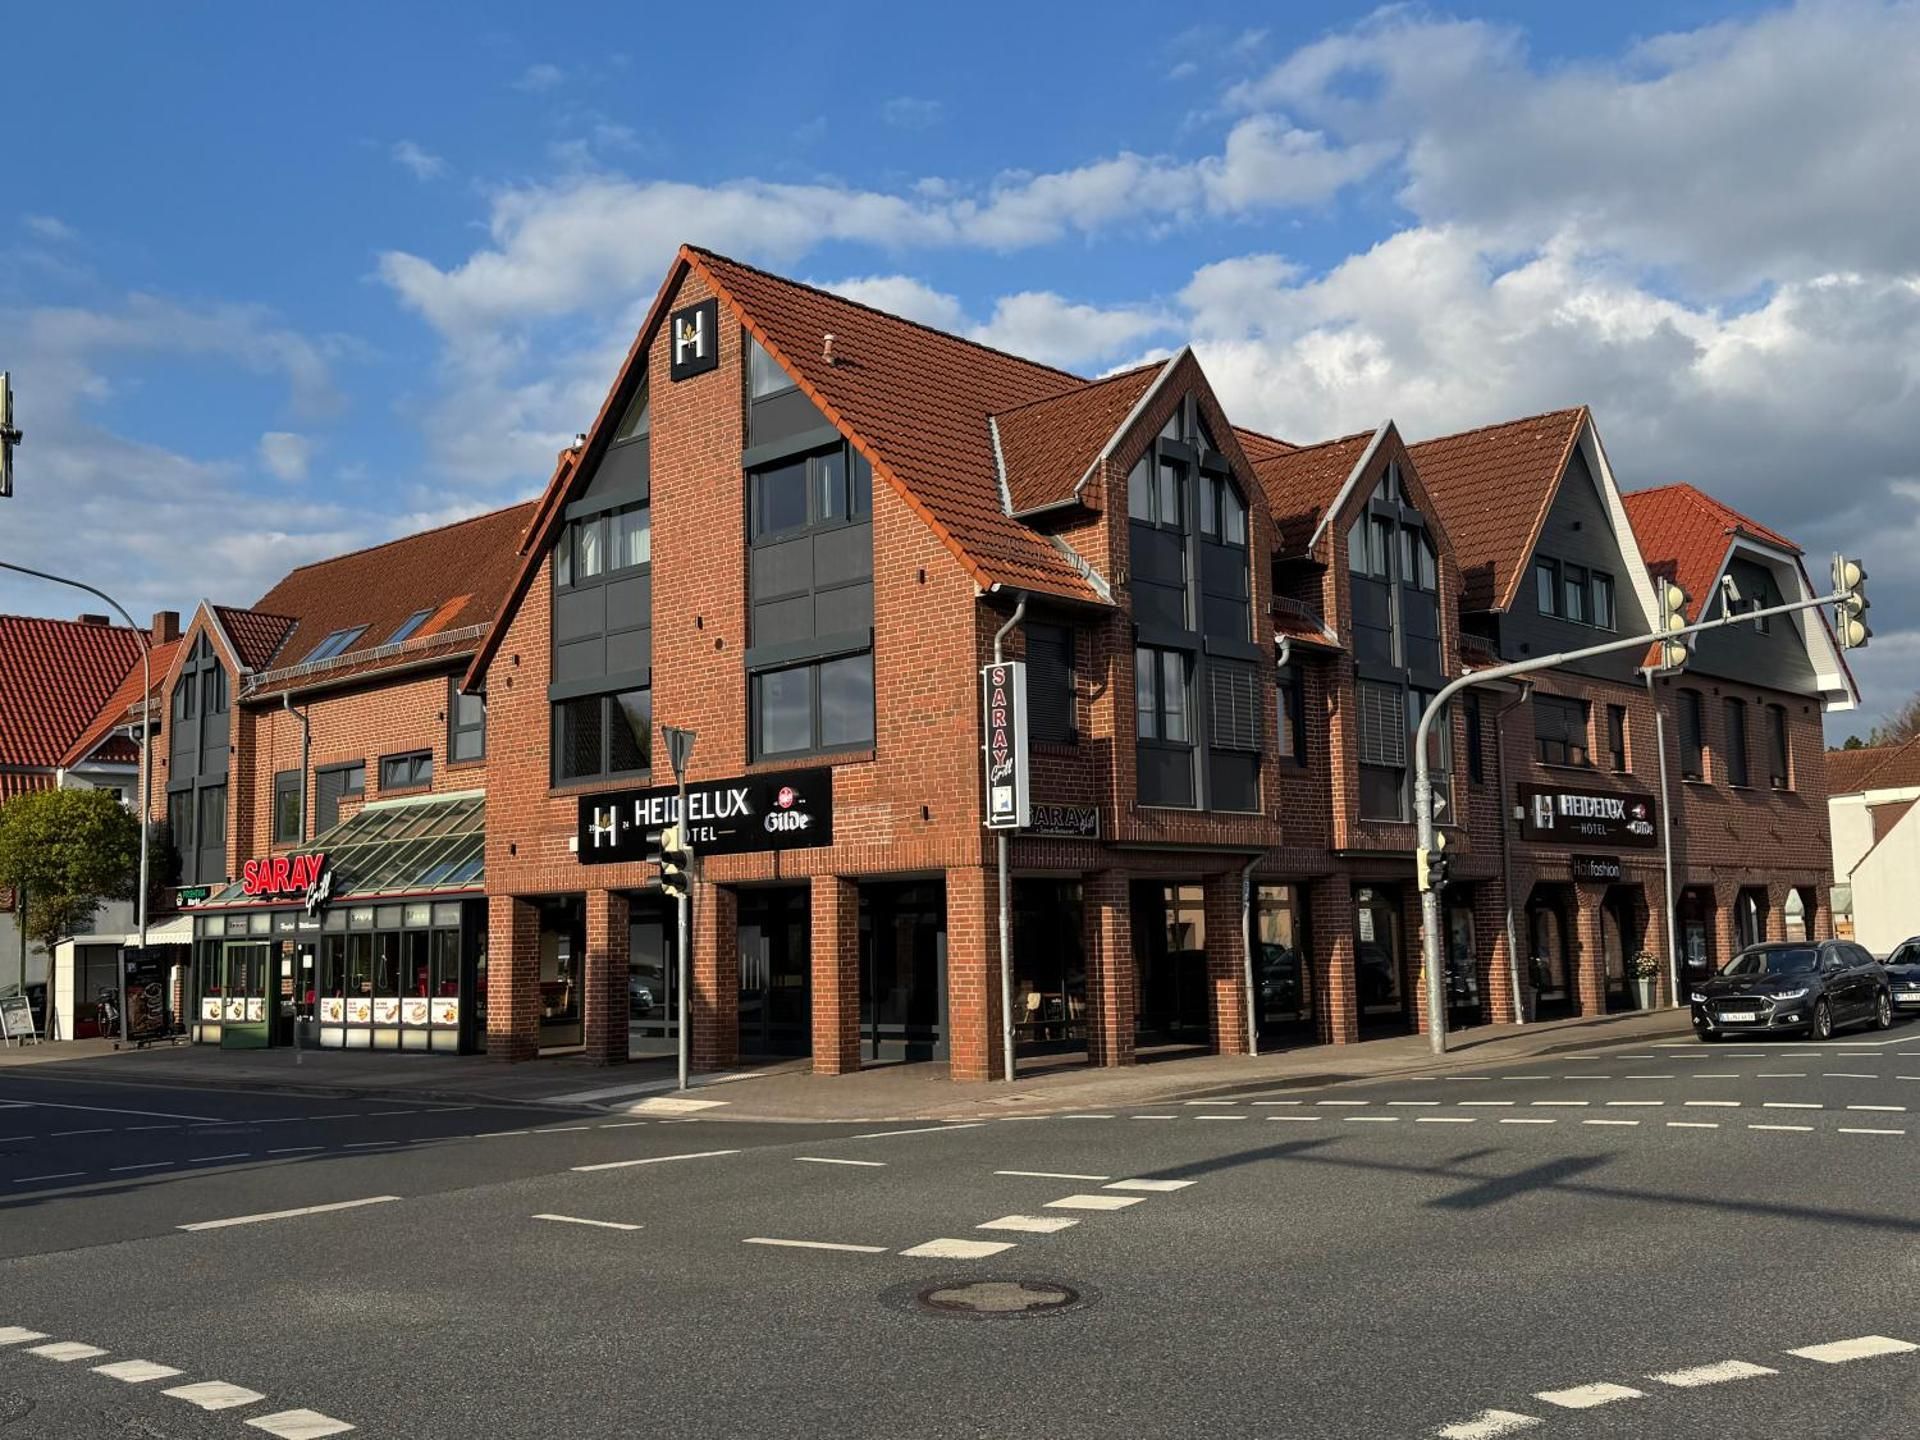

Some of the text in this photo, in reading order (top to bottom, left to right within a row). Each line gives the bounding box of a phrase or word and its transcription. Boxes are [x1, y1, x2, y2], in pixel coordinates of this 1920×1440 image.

[676, 310, 703, 365] H
[991, 667, 1008, 766] SARAY
[990, 757, 1014, 786] Grill
[594, 805, 617, 848] H
[764, 810, 809, 833] Gilde
[1560, 794, 1626, 820] HEIDELUX
[1581, 823, 1607, 836] HOTEL
[242, 852, 325, 896] SARAY
[305, 871, 332, 917] Grill
